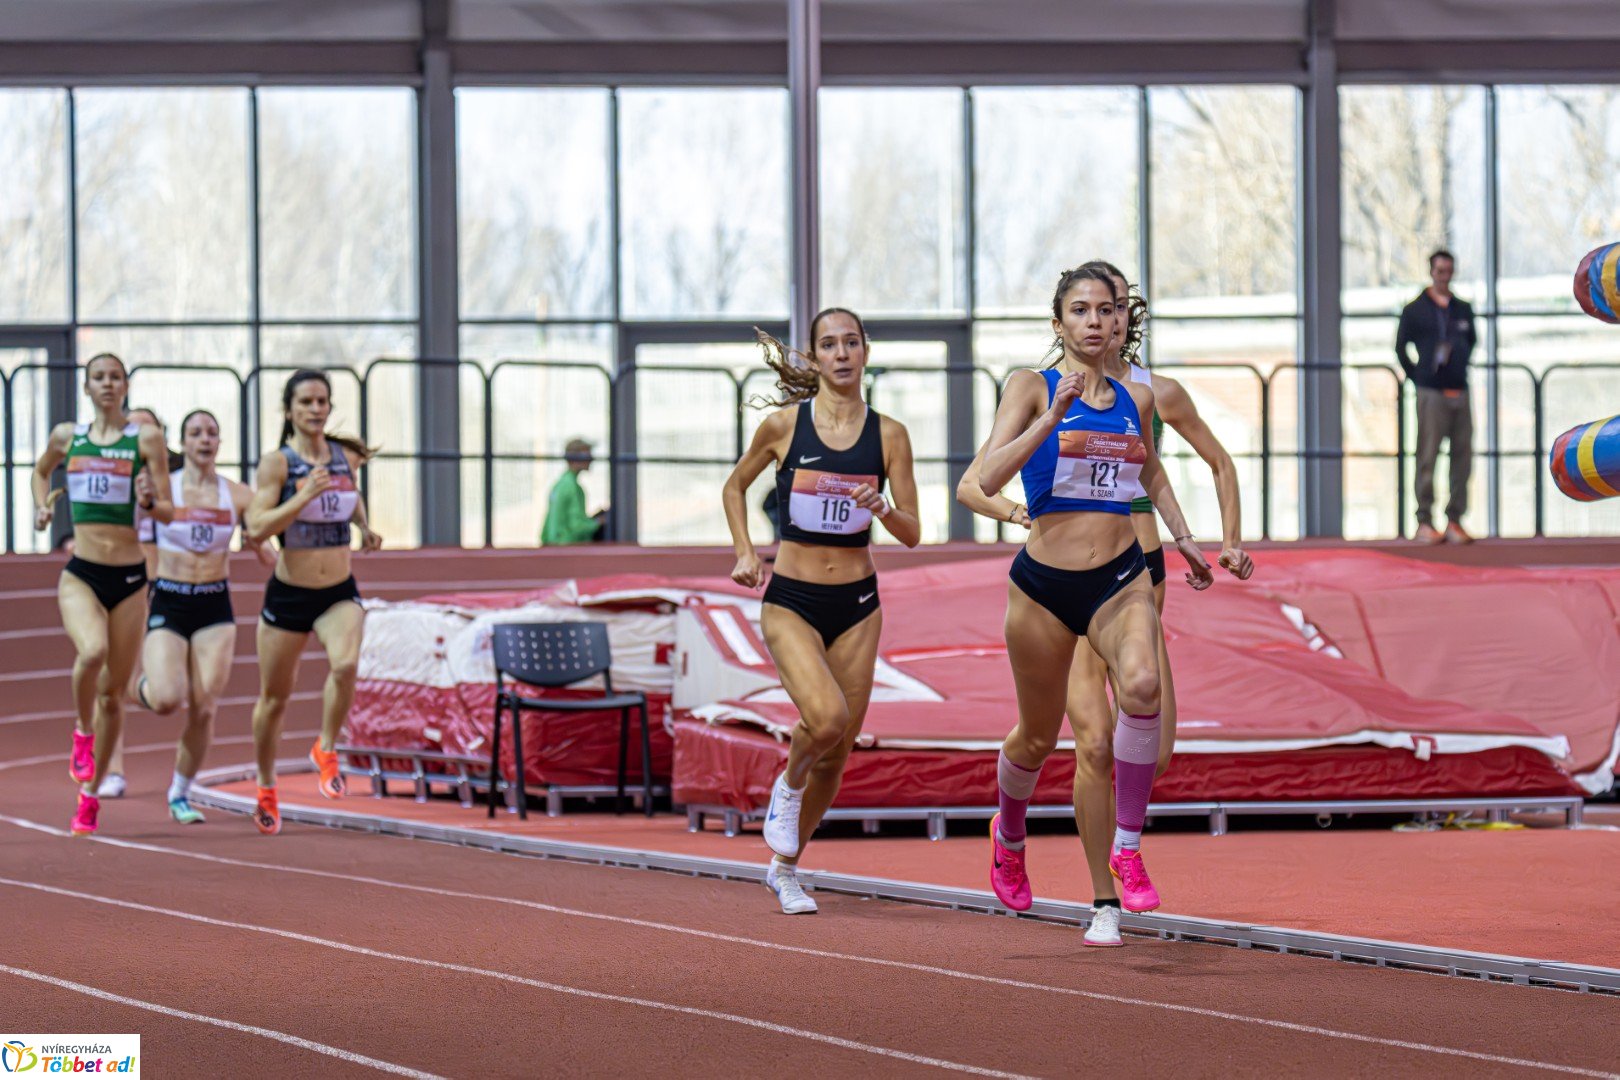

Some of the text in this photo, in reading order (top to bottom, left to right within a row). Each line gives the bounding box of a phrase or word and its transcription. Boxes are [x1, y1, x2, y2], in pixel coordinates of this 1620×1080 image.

[88, 474, 109, 495] 113
[1090, 462, 1120, 488] 121
[1090, 488, 1097, 497] K.
[320, 494, 340, 513] 112
[821, 498, 851, 522] 116
[191, 524, 213, 543] 130
[156, 579, 192, 595] NIKE
